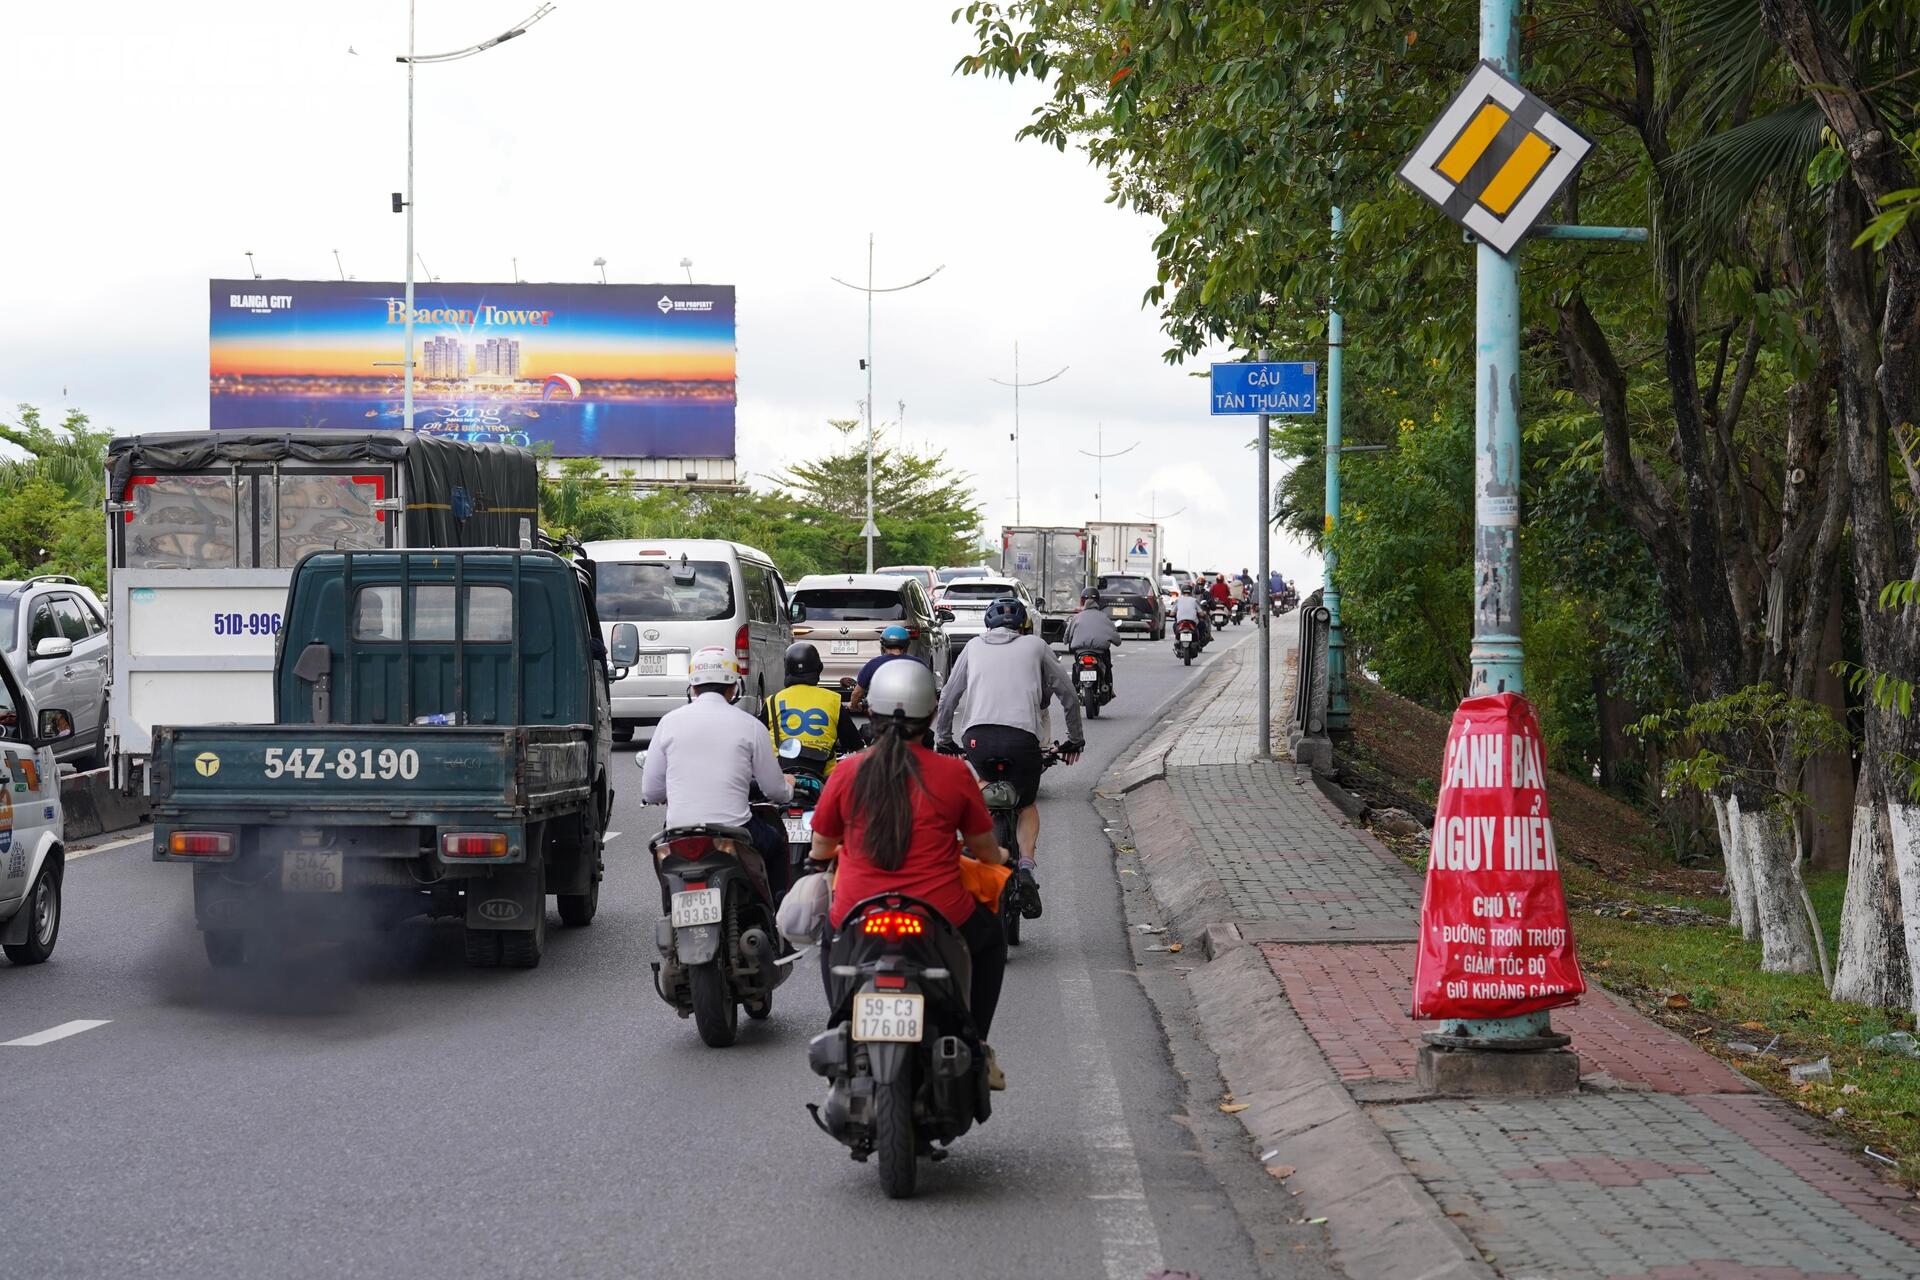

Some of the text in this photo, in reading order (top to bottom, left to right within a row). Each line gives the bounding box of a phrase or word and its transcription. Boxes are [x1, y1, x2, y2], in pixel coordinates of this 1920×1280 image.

[270, 296, 292, 309] CITY
[480, 305, 555, 326] Tower
[1216, 391, 1311, 411] TÂN THUẬN 2
[214, 613, 281, 635] 51D-996
[695, 662, 723, 671] HDBank
[779, 699, 829, 736] be
[264, 747, 419, 780] 54Z-8190
[1429, 815, 1497, 872] NGUY
[486, 903, 516, 916] KIA
[677, 906, 719, 924] 193.69
[1472, 892, 1504, 919] CHÚ
[1442, 922, 1487, 946] ĐƯỜNG
[1528, 927, 1567, 951] TRƯỢT
[1464, 951, 1547, 979] GIẢM TỐC ĐỘ
[1473, 980, 1526, 1000] KHOẢNG
[865, 998, 913, 1016] 59-C3
[861, 1018, 918, 1038] 176.08
